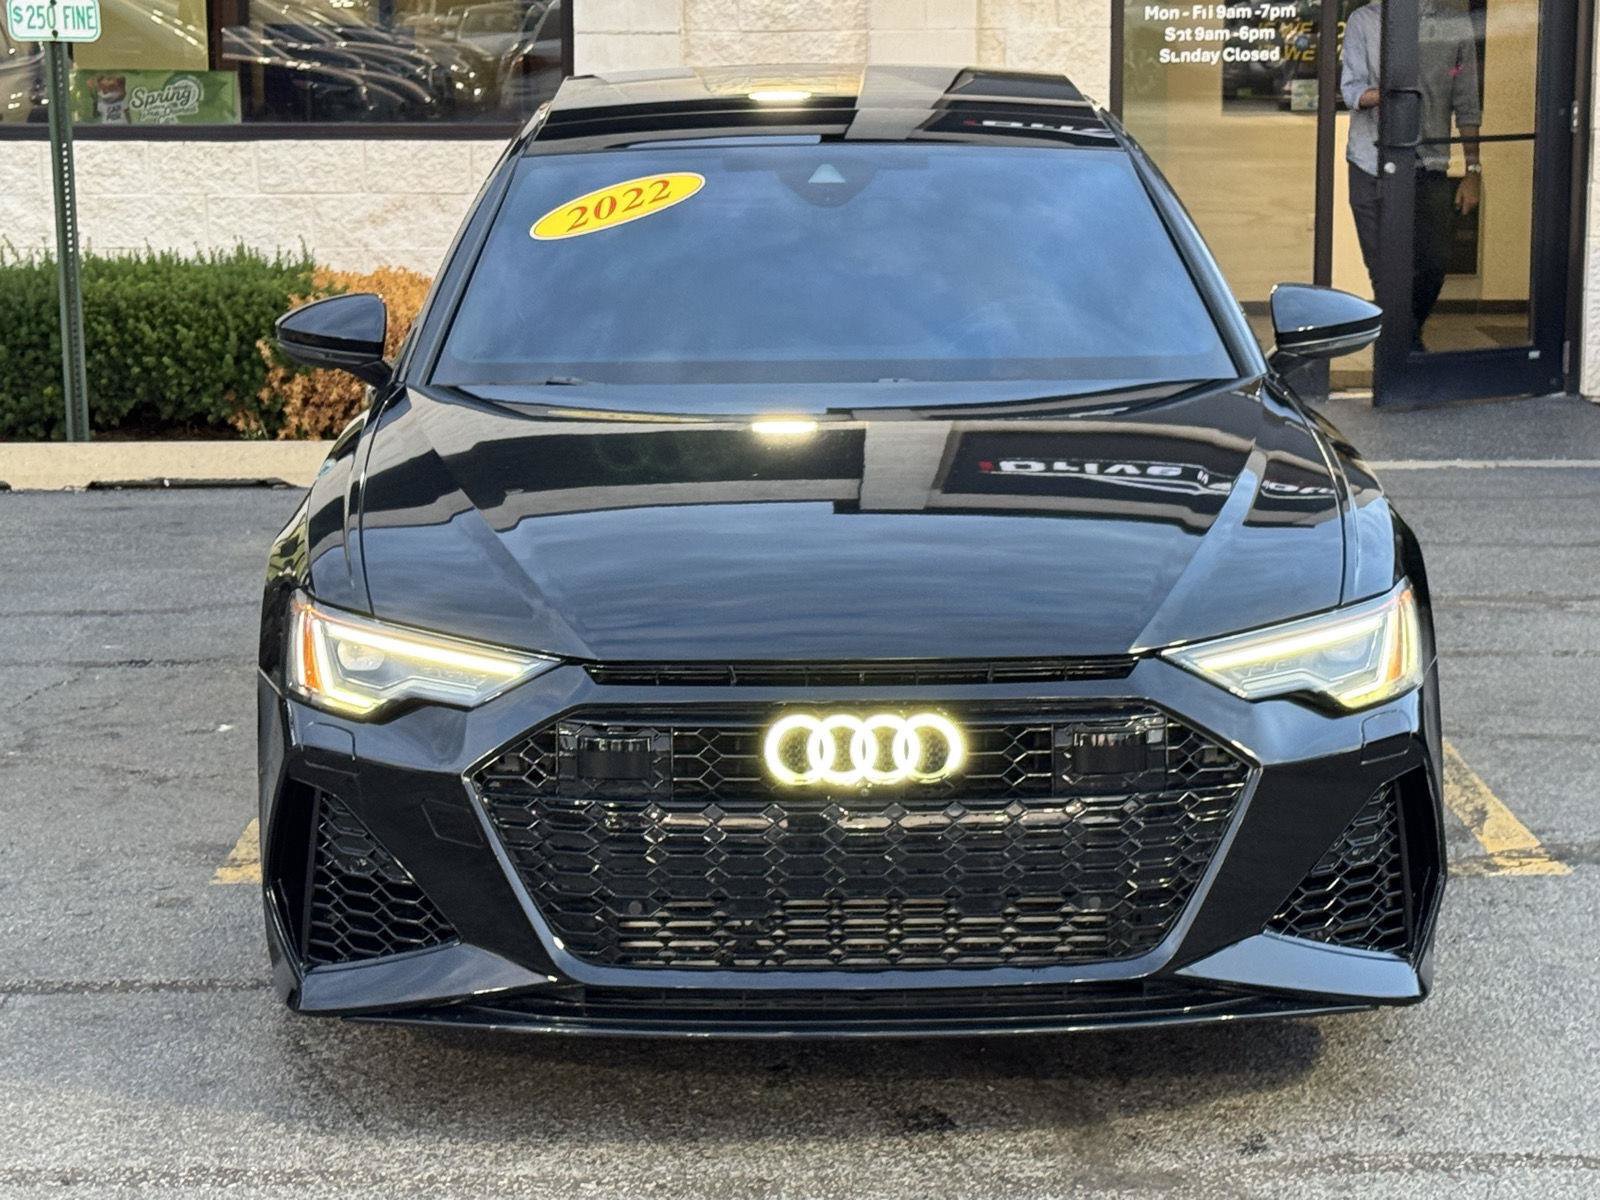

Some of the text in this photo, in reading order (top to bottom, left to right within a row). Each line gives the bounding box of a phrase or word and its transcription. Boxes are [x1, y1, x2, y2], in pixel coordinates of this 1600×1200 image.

[13, 5, 96, 29] $250 FINE
[1145, 5, 1180, 20] Mon
[1216, 4, 1252, 19] 9am
[1195, 26, 1230, 41] 9am
[1222, 46, 1280, 62] Closed
[131, 85, 191, 108] Spring
[566, 179, 672, 232] 2022
